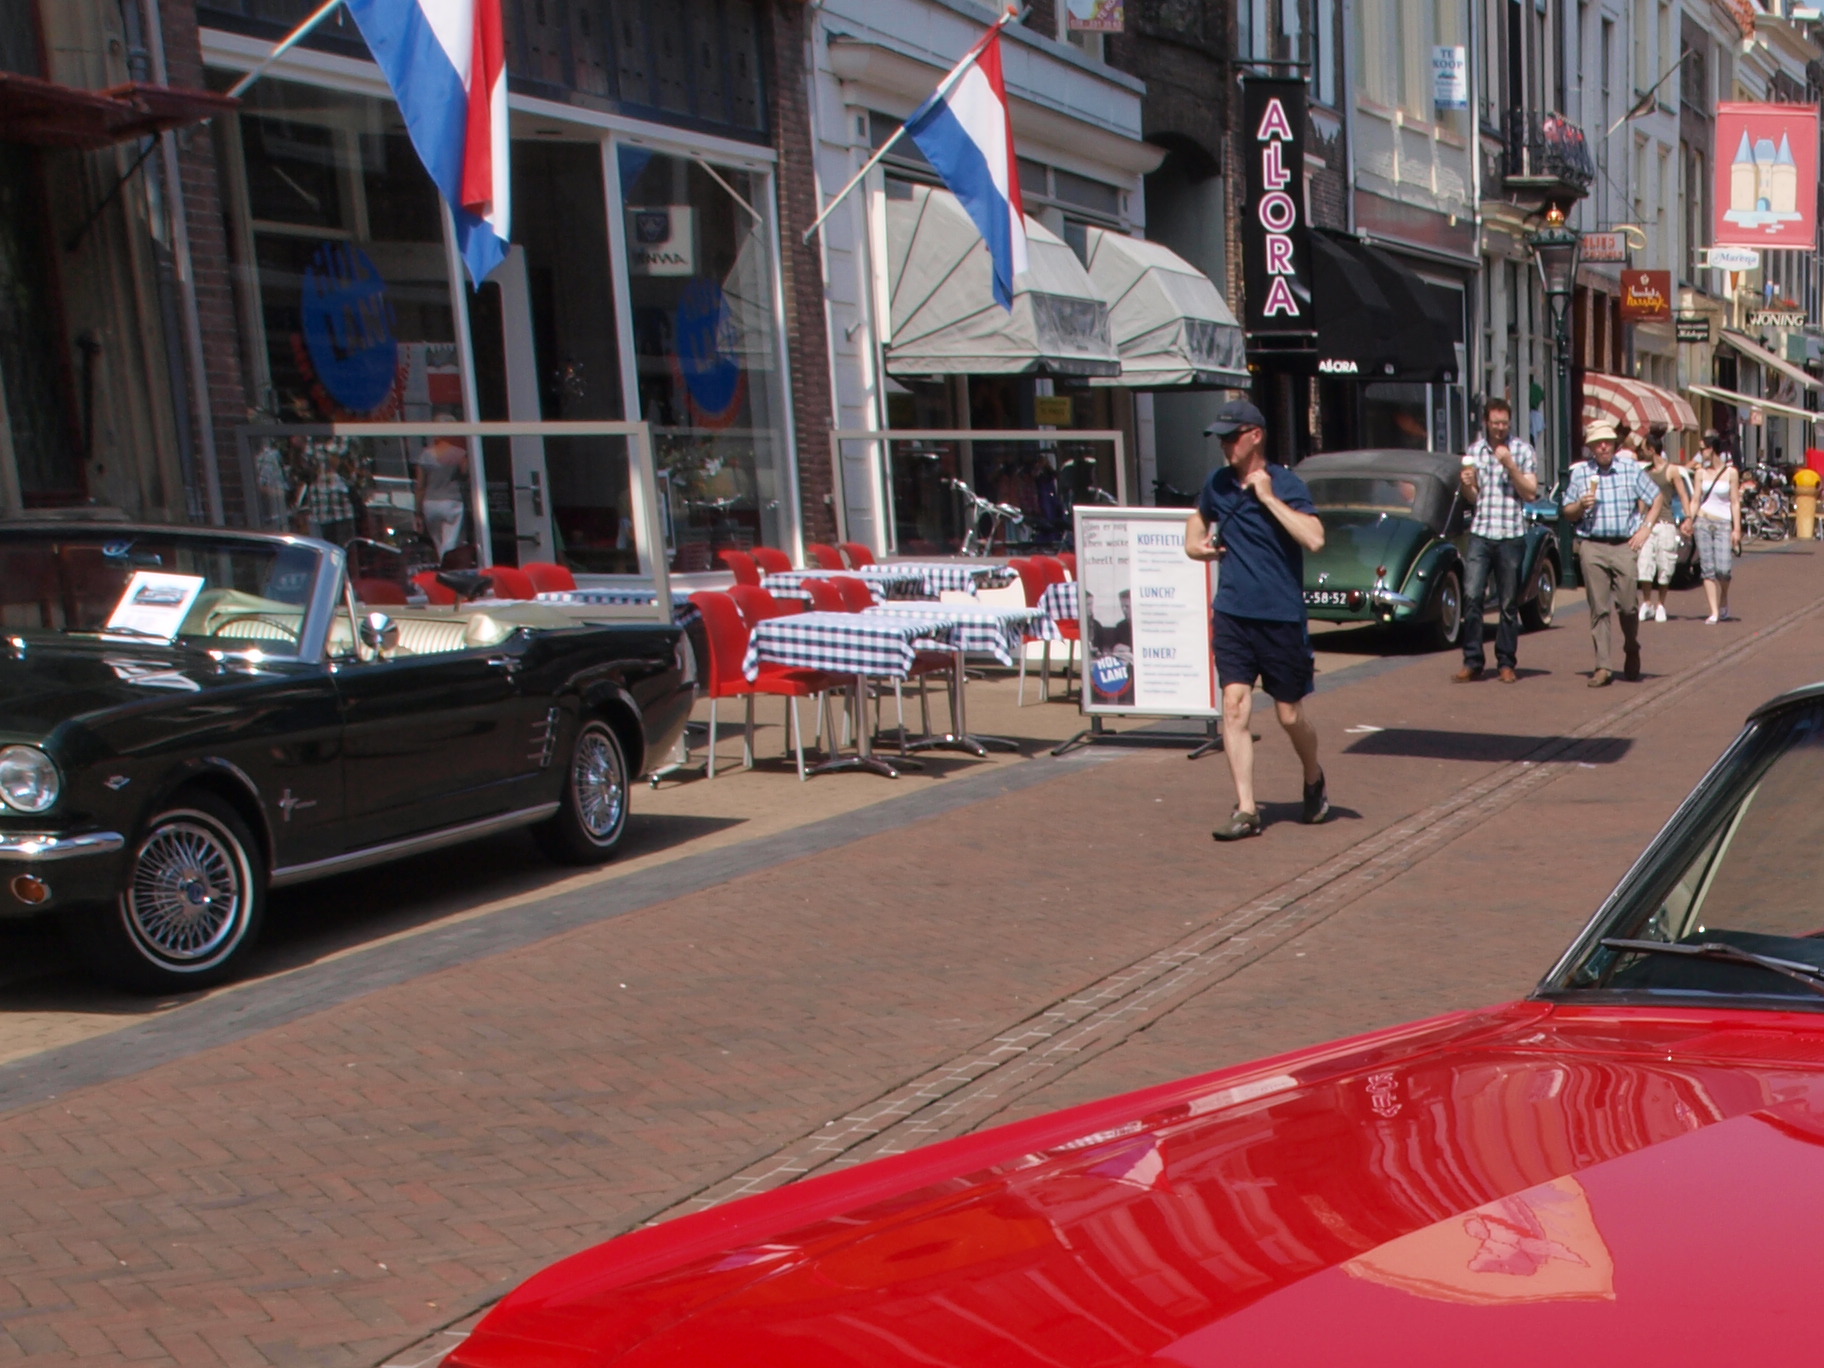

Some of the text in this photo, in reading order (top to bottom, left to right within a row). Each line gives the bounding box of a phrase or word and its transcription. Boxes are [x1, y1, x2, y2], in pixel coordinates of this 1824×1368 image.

[1433, 60, 1464, 69] KOOP
[1257, 98, 1300, 316] ALLORA
[1140, 587, 1175, 599] LUNCH?
[1142, 647, 1177, 659] DINER?
